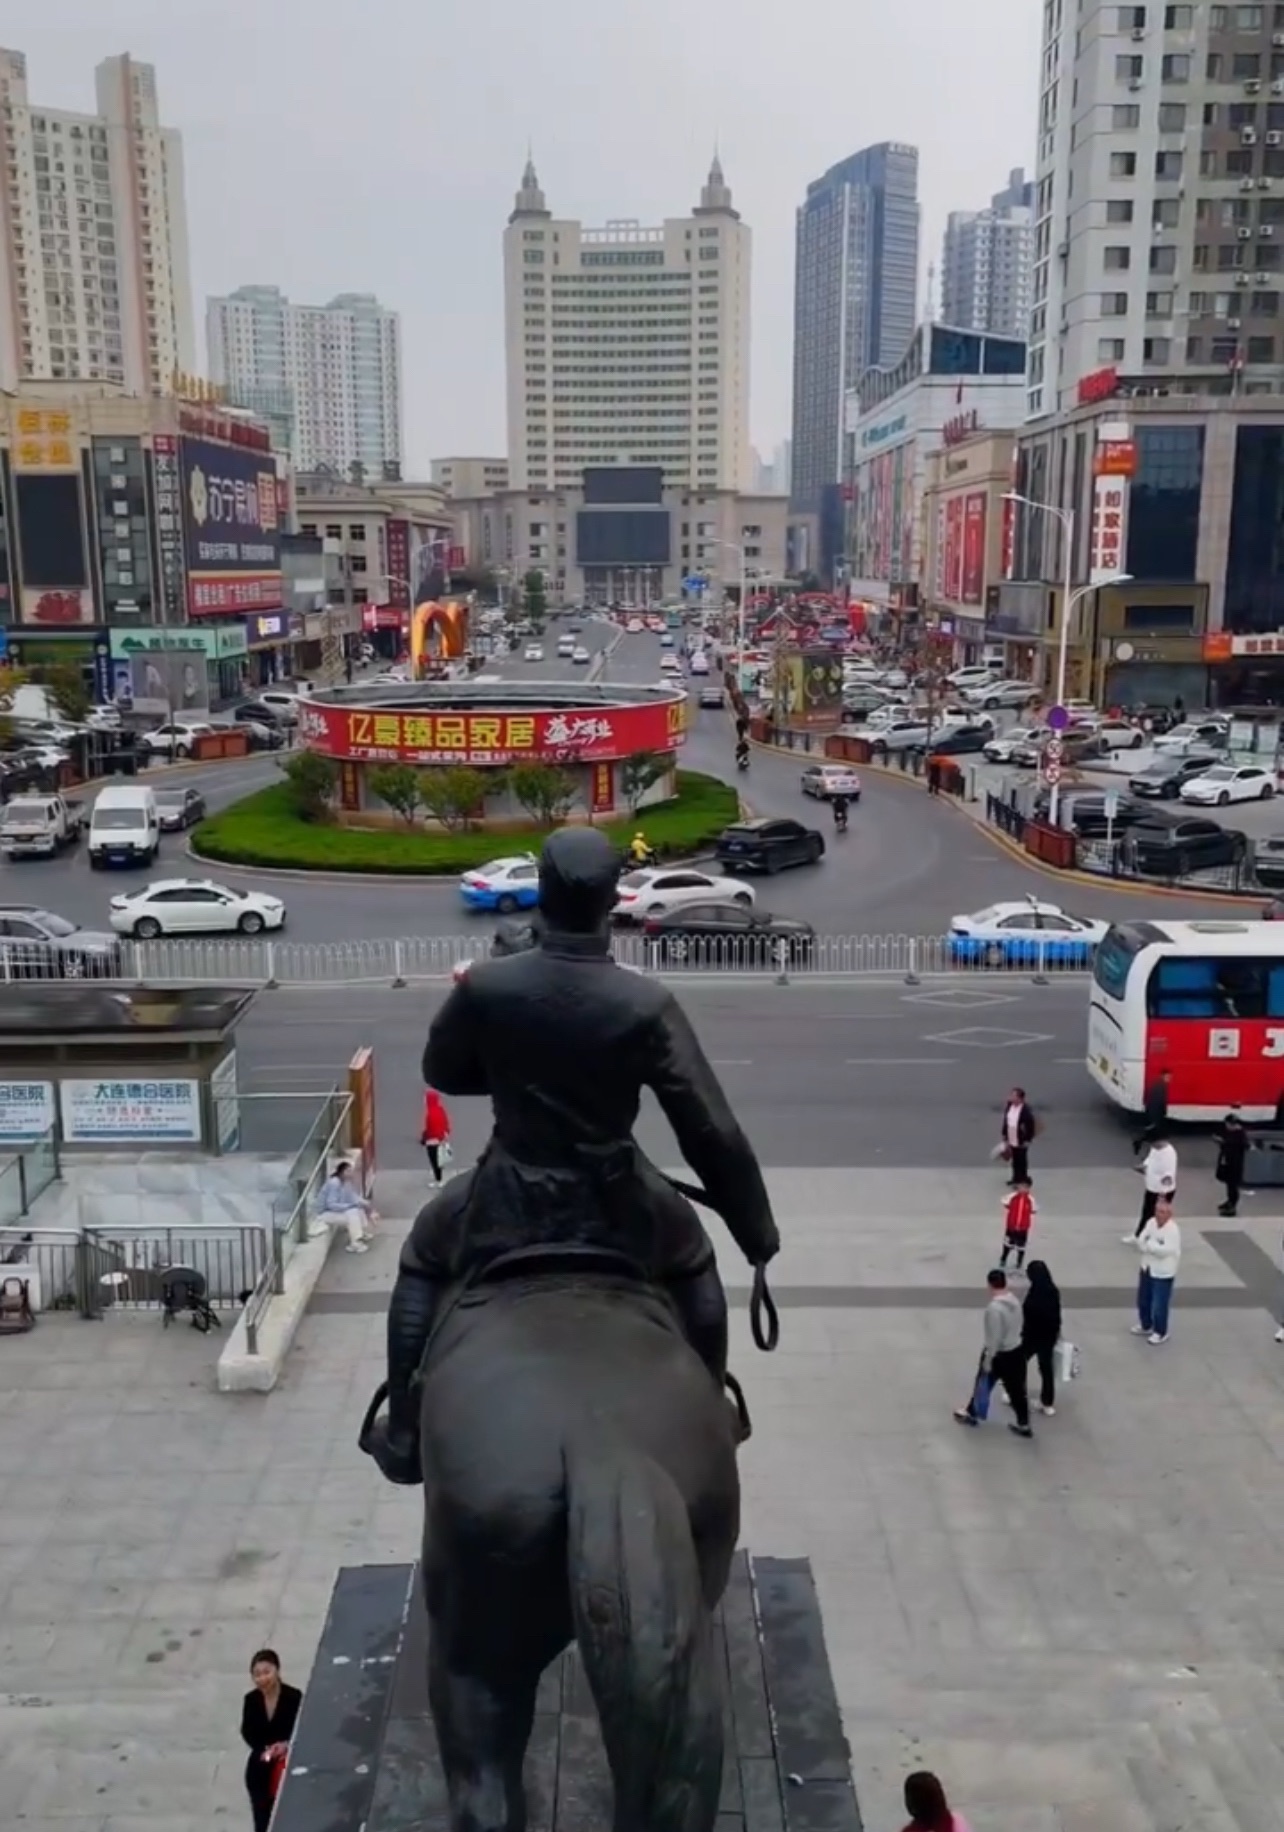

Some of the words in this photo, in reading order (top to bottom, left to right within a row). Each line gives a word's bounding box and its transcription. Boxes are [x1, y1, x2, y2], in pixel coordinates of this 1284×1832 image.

[1101, 490, 1121, 569] 如家酒店
[348, 713, 535, 748] 亿豪臻品家居
[94, 1083, 192, 1099] 大连德合医院
